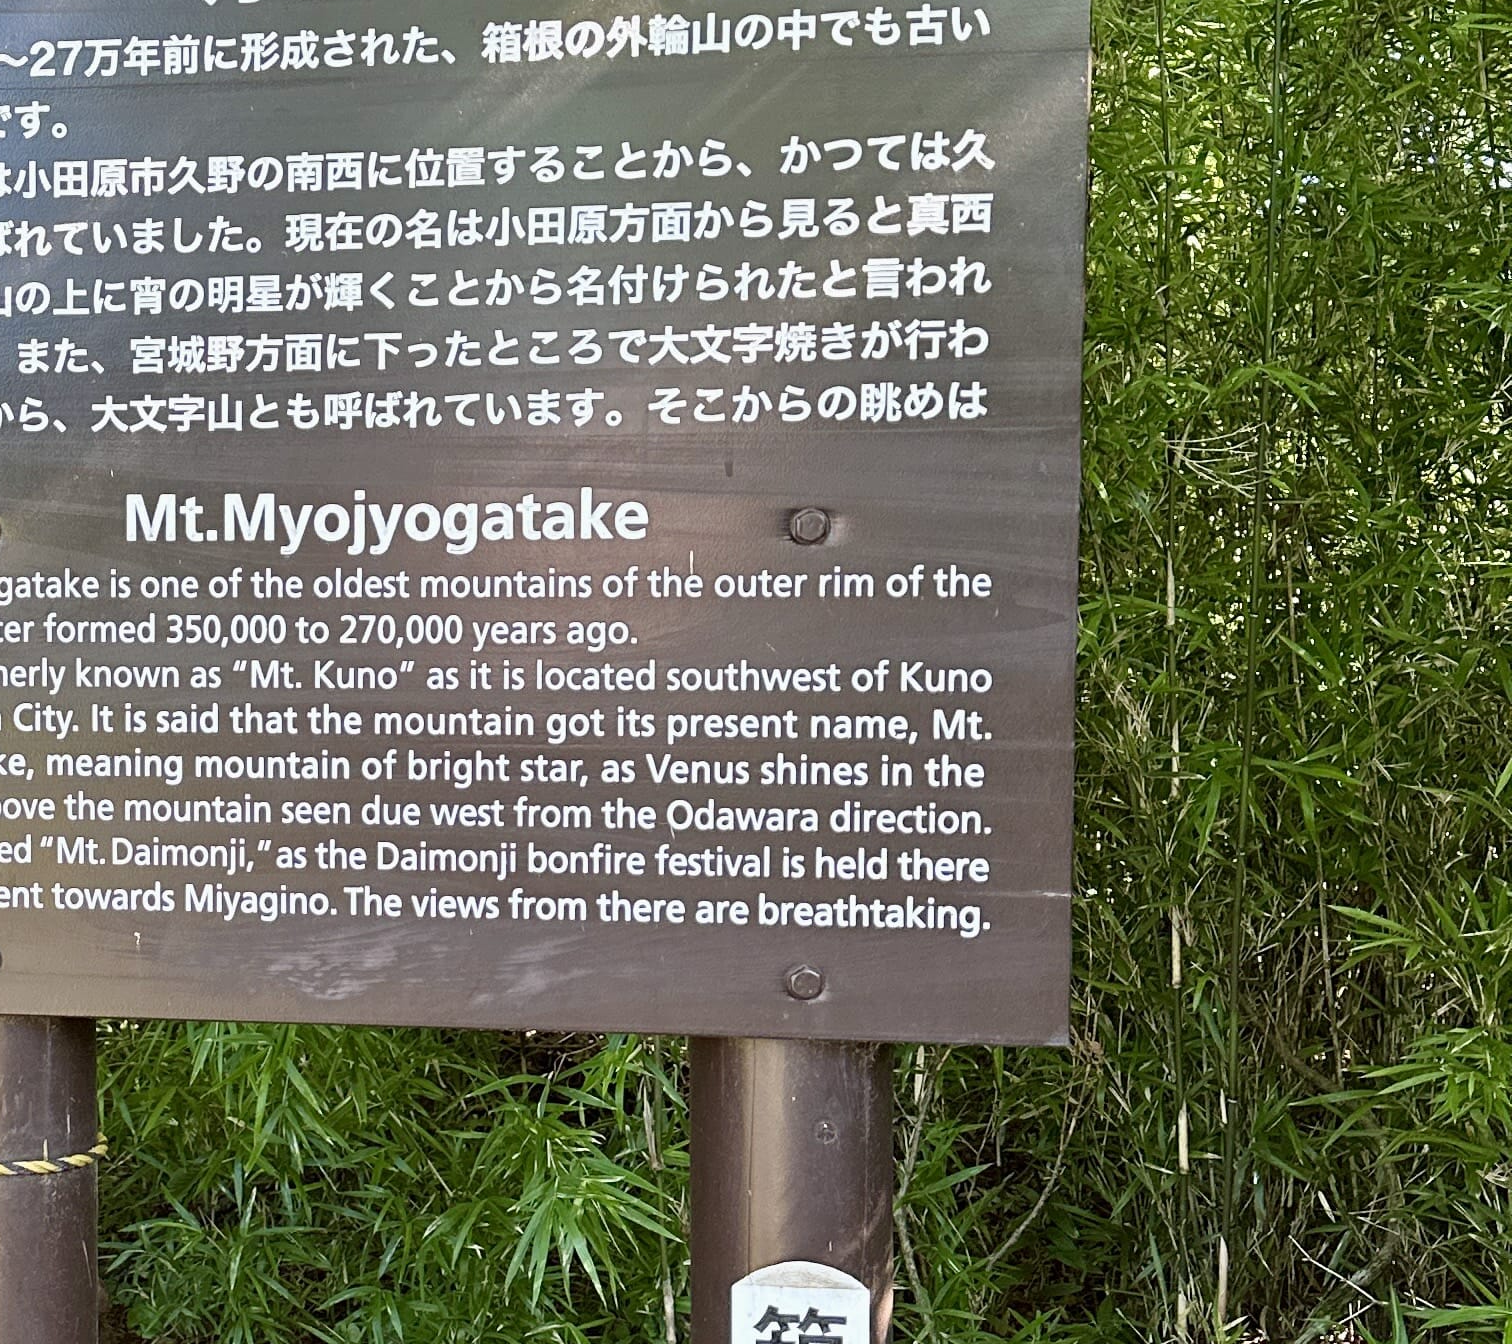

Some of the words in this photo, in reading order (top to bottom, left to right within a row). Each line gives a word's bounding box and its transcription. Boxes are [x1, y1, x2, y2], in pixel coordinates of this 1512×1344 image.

[126, 486, 649, 556] Mt.Myojyogatake
[110, 568, 132, 599] is
[140, 576, 199, 599] one
[208, 567, 243, 599] of
[250, 567, 304, 599] the
[313, 567, 410, 599] oldest
[420, 567, 593, 599] mountains
[602, 565, 639, 598] of
[646, 565, 704, 598] the
[714, 569, 808, 598] outer
[818, 565, 874, 598] rim
[886, 564, 925, 598] of
[932, 564, 992, 598] the
[42, 612, 156, 644] formed
[166, 614, 287, 649] 350,000
[294, 616, 330, 644] to
[339, 614, 463, 650] 270,000
[472, 621, 557, 653] years
[566, 621, 638, 653] ago.
[75, 657, 180, 688] known
[190, 666, 222, 689] as
[426, 667, 460, 690] as
[470, 659, 492, 690] it
[503, 659, 525, 691] is
[536, 659, 656, 691] located
[666, 659, 842, 692] southwest
[851, 659, 890, 693] of
[900, 661, 993, 693] Kuno
[13, 702, 79, 740] City.
[91, 703, 114, 733] It
[124, 702, 147, 734] is
[156, 702, 219, 734] said
[228, 702, 298, 735] that
[306, 703, 363, 735] the
[374, 705, 534, 736] mountain
[546, 708, 605, 745] got
[617, 705, 656, 738] its
[667, 709, 799, 746] present
[810, 715, 918, 745] name,
[933, 708, 992, 741] Mt.
[46, 747, 183, 786] meaning
[195, 749, 350, 780] mountain
[361, 748, 398, 781] of
[408, 749, 510, 789] bright
[520, 754, 589, 788] star,
[600, 759, 636, 784] as
[645, 753, 750, 785] Venus
[760, 752, 869, 786] shines
[881, 754, 913, 787] in
[923, 754, 985, 788] the
[63, 790, 115, 821] the
[124, 793, 272, 824] mountain
[281, 801, 351, 825] seen
[361, 794, 421, 826] due
[429, 799, 505, 827] west
[512, 795, 592, 829] from
[600, 797, 657, 830] the
[666, 798, 819, 834] Odawara
[829, 800, 992, 835] direction.
[275, 846, 308, 869] as
[314, 838, 367, 870] the
[377, 840, 517, 881] Daimonji
[527, 841, 646, 876] bonfire
[654, 843, 771, 878] festival
[782, 846, 806, 879] is
[815, 846, 888, 880] held
[896, 847, 990, 883] there
[50, 880, 176, 912] towards
[185, 883, 338, 922] Miyagino.
[343, 885, 403, 918] The
[410, 887, 500, 920] views
[507, 887, 587, 921] from
[595, 889, 686, 924] there
[695, 900, 750, 925] are
[758, 892, 991, 939] breathtaking.
